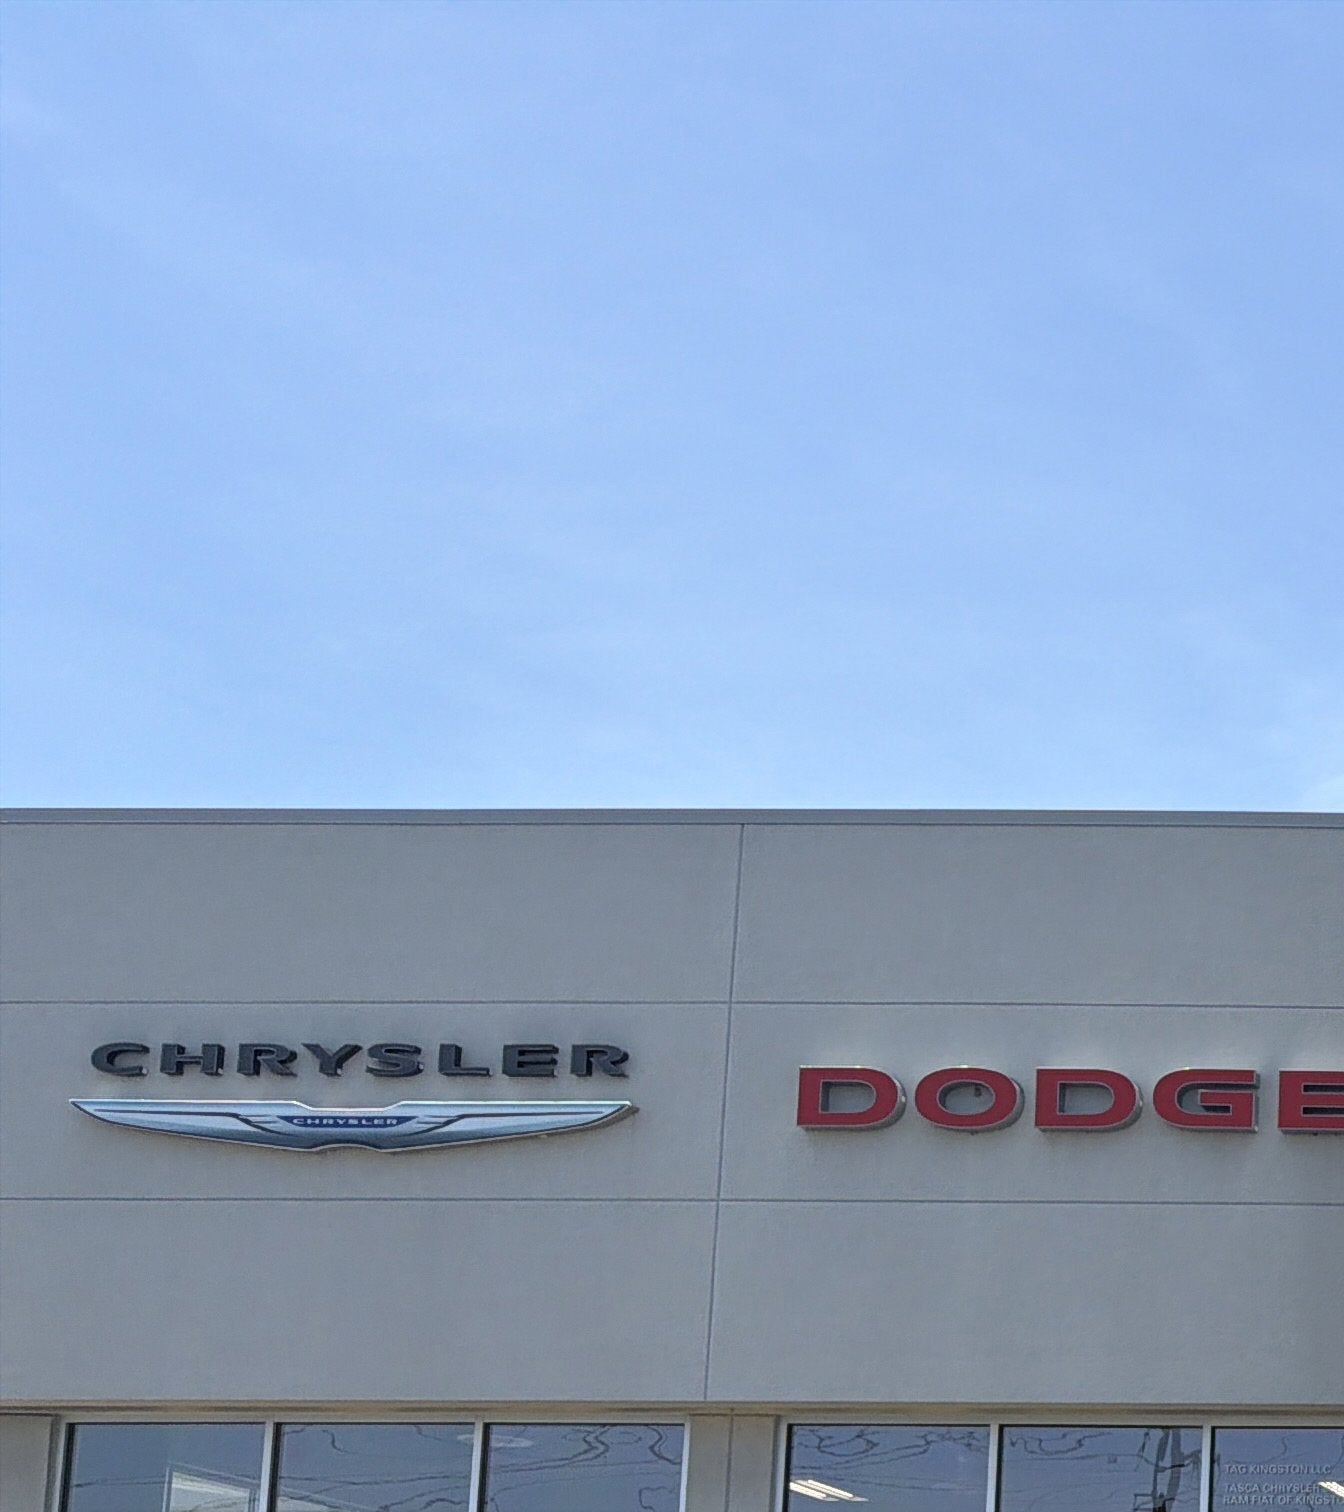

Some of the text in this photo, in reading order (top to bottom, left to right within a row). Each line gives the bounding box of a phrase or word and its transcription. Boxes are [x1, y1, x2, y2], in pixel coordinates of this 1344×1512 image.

[91, 1042, 630, 1077] CHRYSLER
[1224, 1464, 1331, 1474] TAG KINGSTON LLC
[1225, 1483, 1320, 1493] TASCA CHRYSLER
[1223, 1496, 1248, 1505] RAM
[1250, 1496, 1275, 1505] FIAT
[1278, 1496, 1293, 1505] OF
